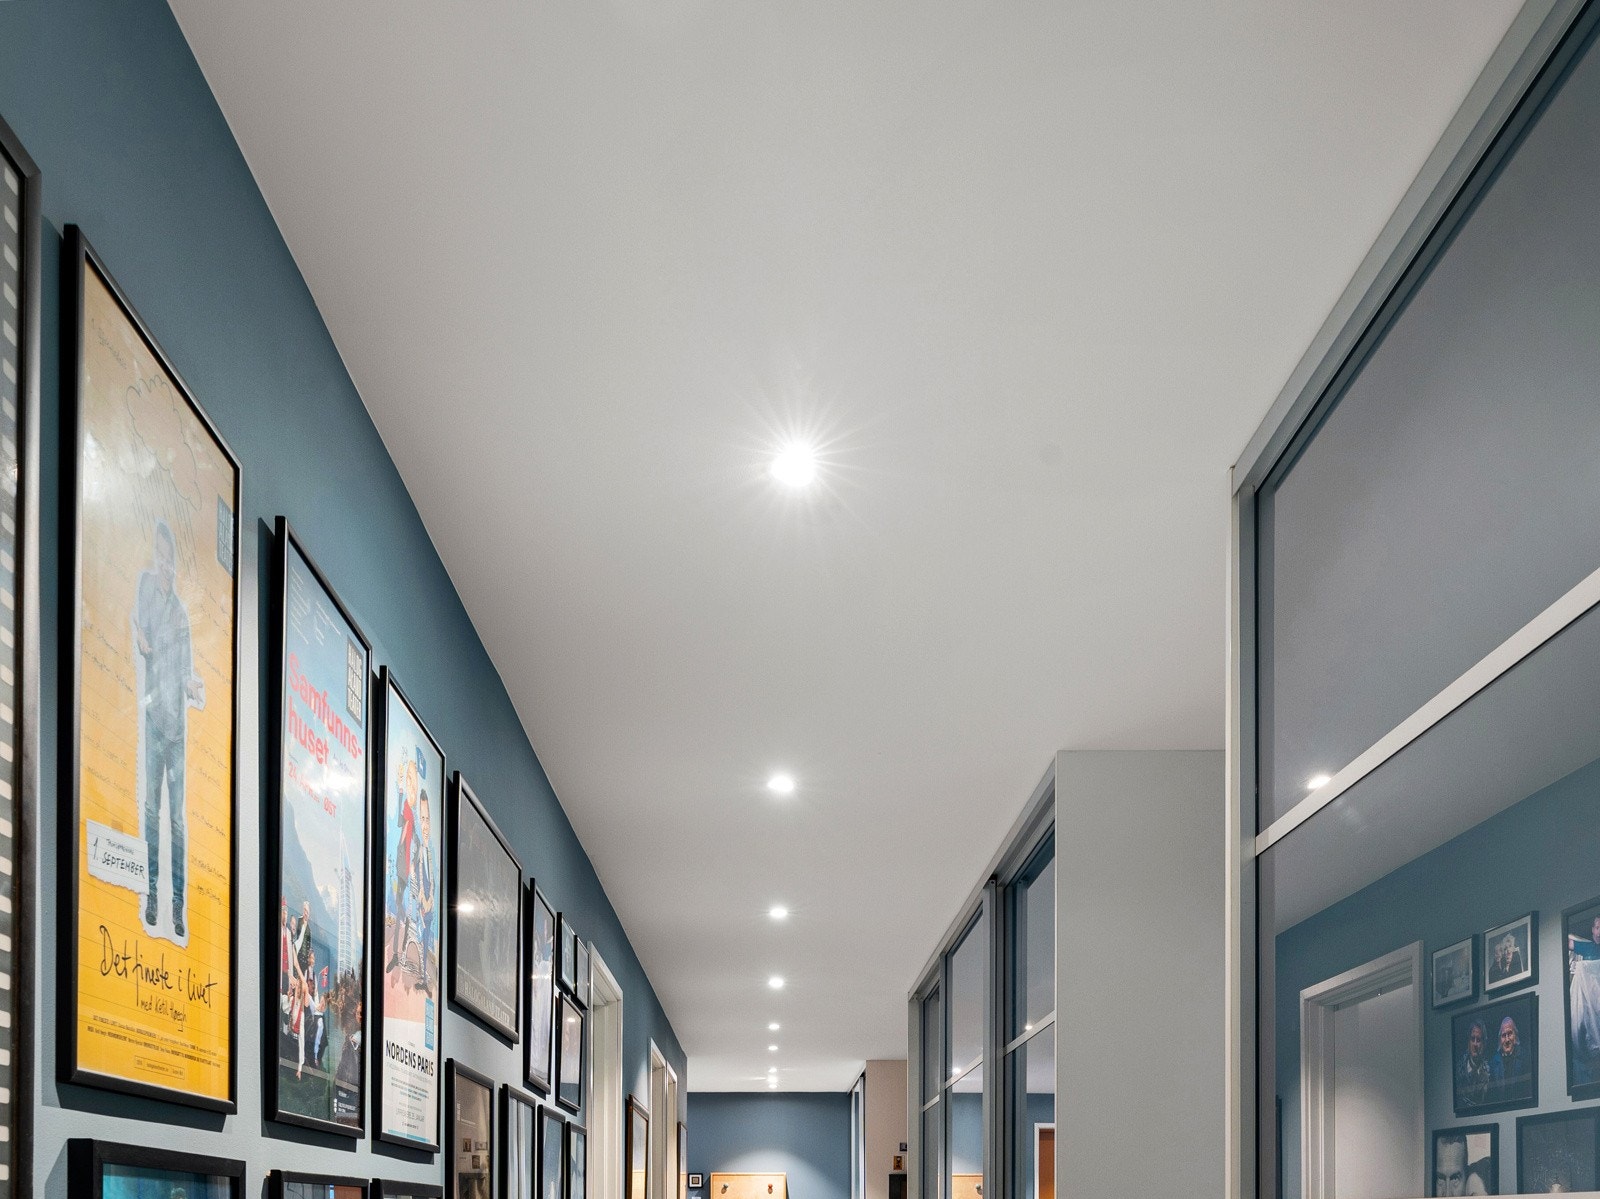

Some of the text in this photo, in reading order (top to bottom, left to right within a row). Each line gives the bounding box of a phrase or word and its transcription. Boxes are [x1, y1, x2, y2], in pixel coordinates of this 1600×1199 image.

[288, 696, 329, 767] huset
[289, 652, 363, 760] Samfunns-
[102, 852, 145, 879] SEPTEMBER
[99, 924, 131, 979] Det
[132, 940, 173, 1006] fineste
[188, 968, 218, 1008] livet
[140, 995, 153, 1012] med
[386, 1040, 416, 1069] NORDENS
[417, 1055, 434, 1077] PARIS
